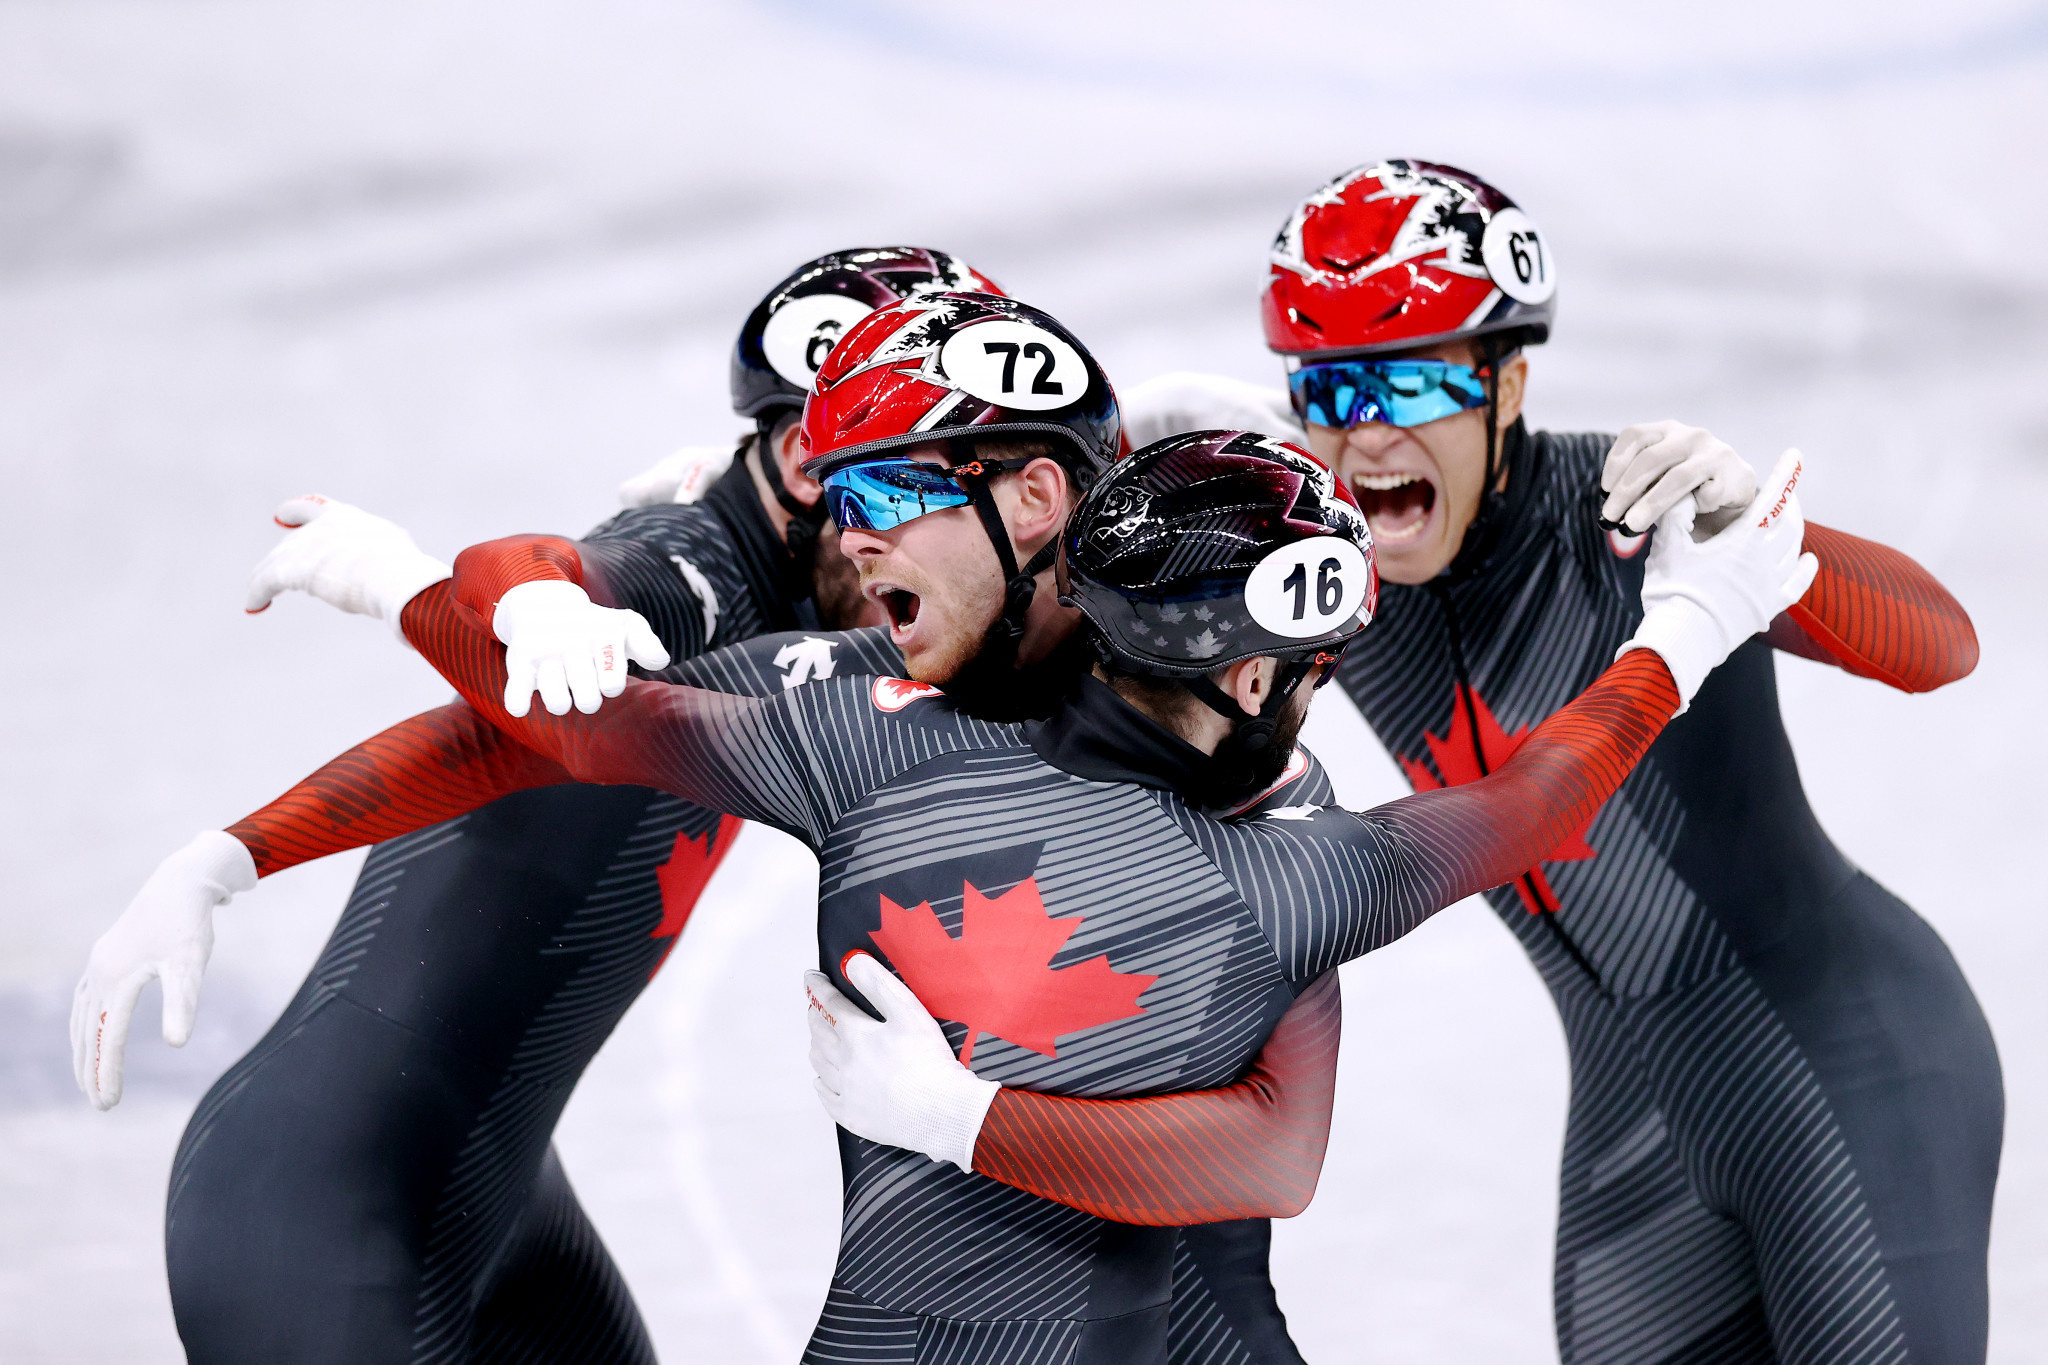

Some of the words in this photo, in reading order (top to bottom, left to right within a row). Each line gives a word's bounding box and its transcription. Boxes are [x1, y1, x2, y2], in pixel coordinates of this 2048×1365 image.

[1509, 231, 1544, 284] 67
[983, 342, 1064, 395] 72
[1768, 460, 1804, 519] AUCLAIR
[1283, 557, 1343, 621] 16
